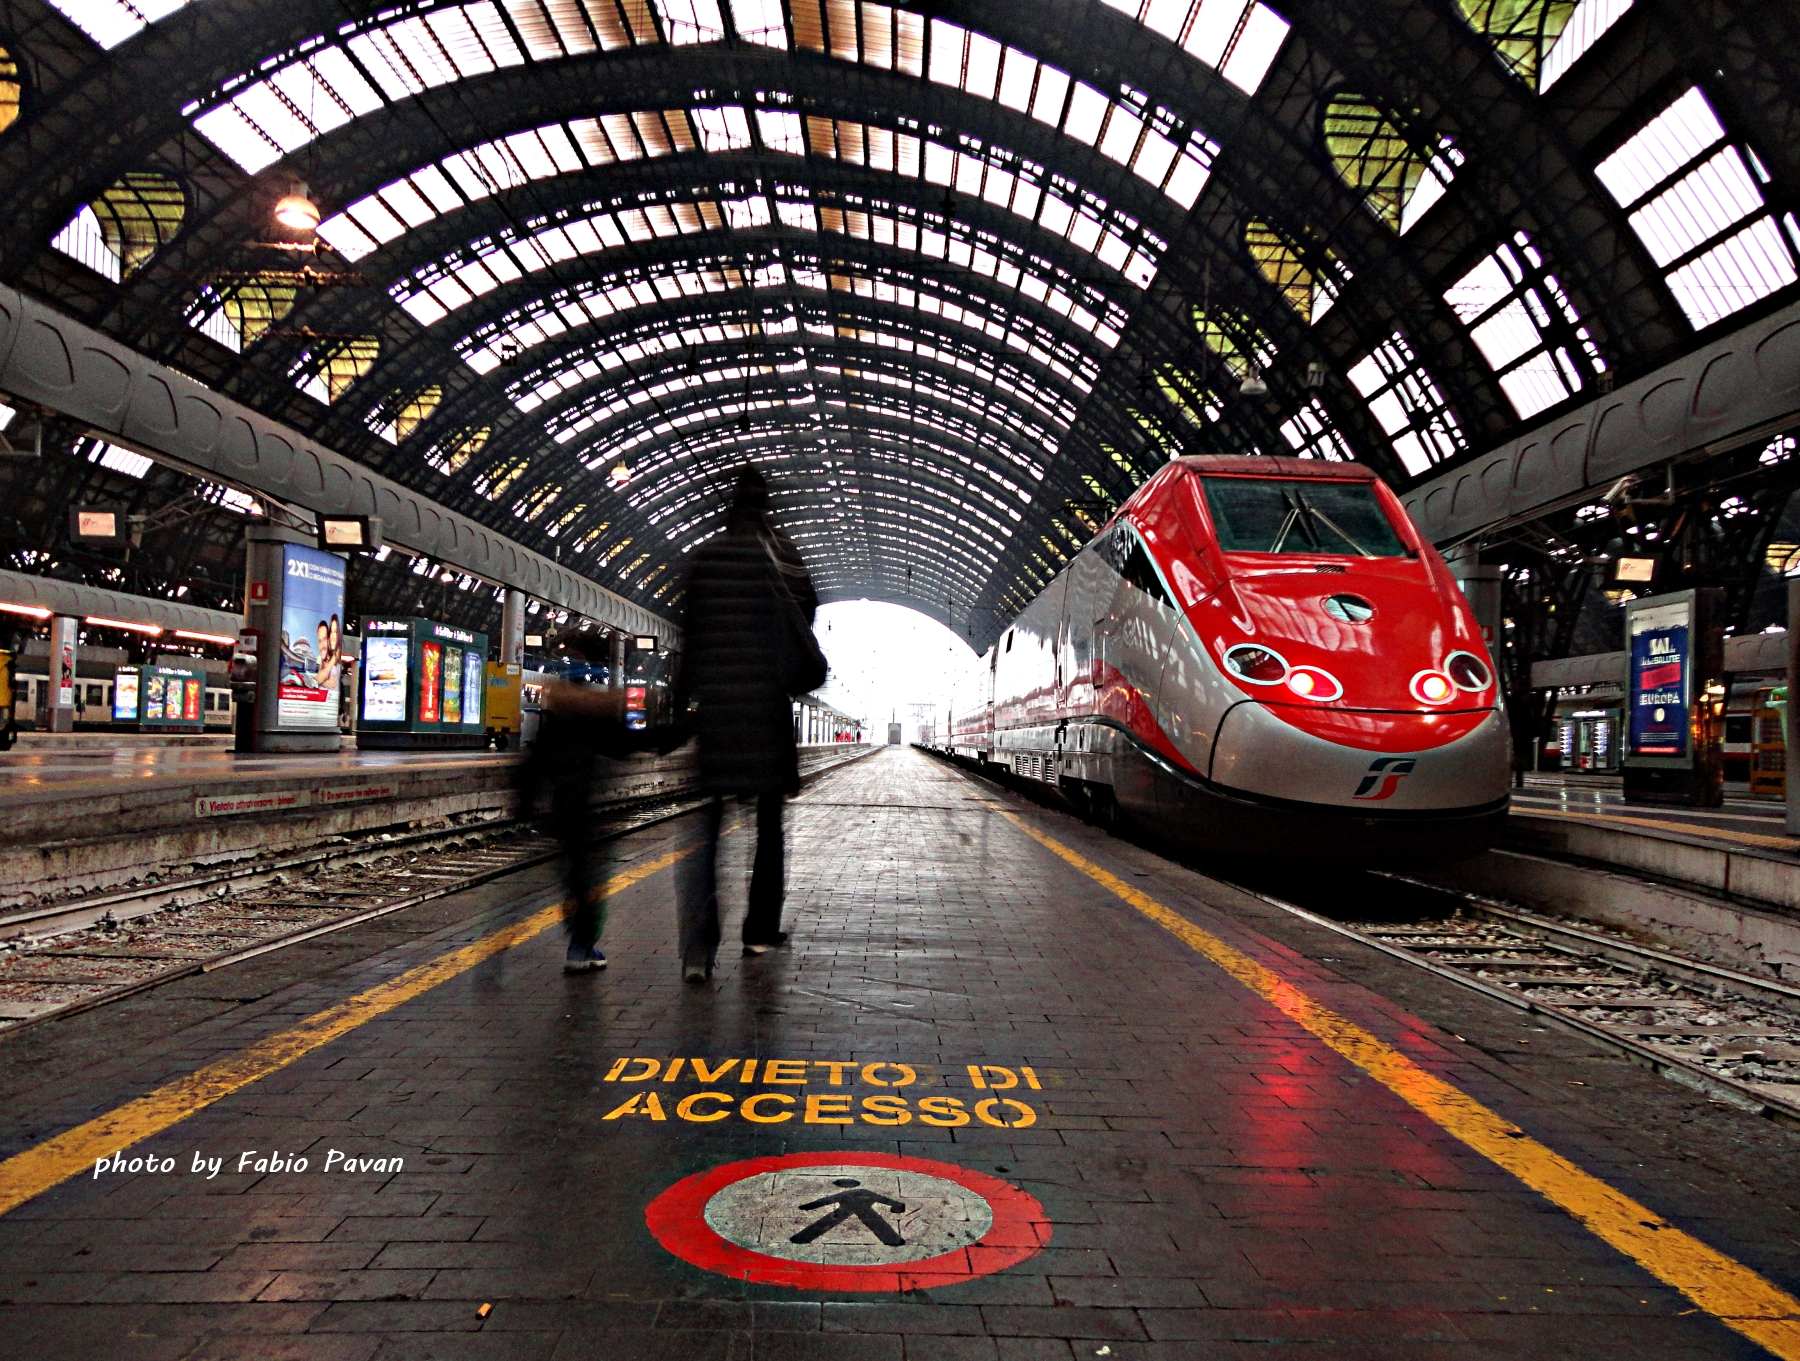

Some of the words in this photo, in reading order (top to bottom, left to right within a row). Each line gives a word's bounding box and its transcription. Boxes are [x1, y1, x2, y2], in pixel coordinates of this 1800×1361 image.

[288, 559, 309, 578] 2X1
[209, 800, 234, 812] Vietato
[603, 1057, 917, 1088] DIVIETO
[966, 1064, 1043, 1090] DI
[601, 1091, 1037, 1128] ACCESSO
